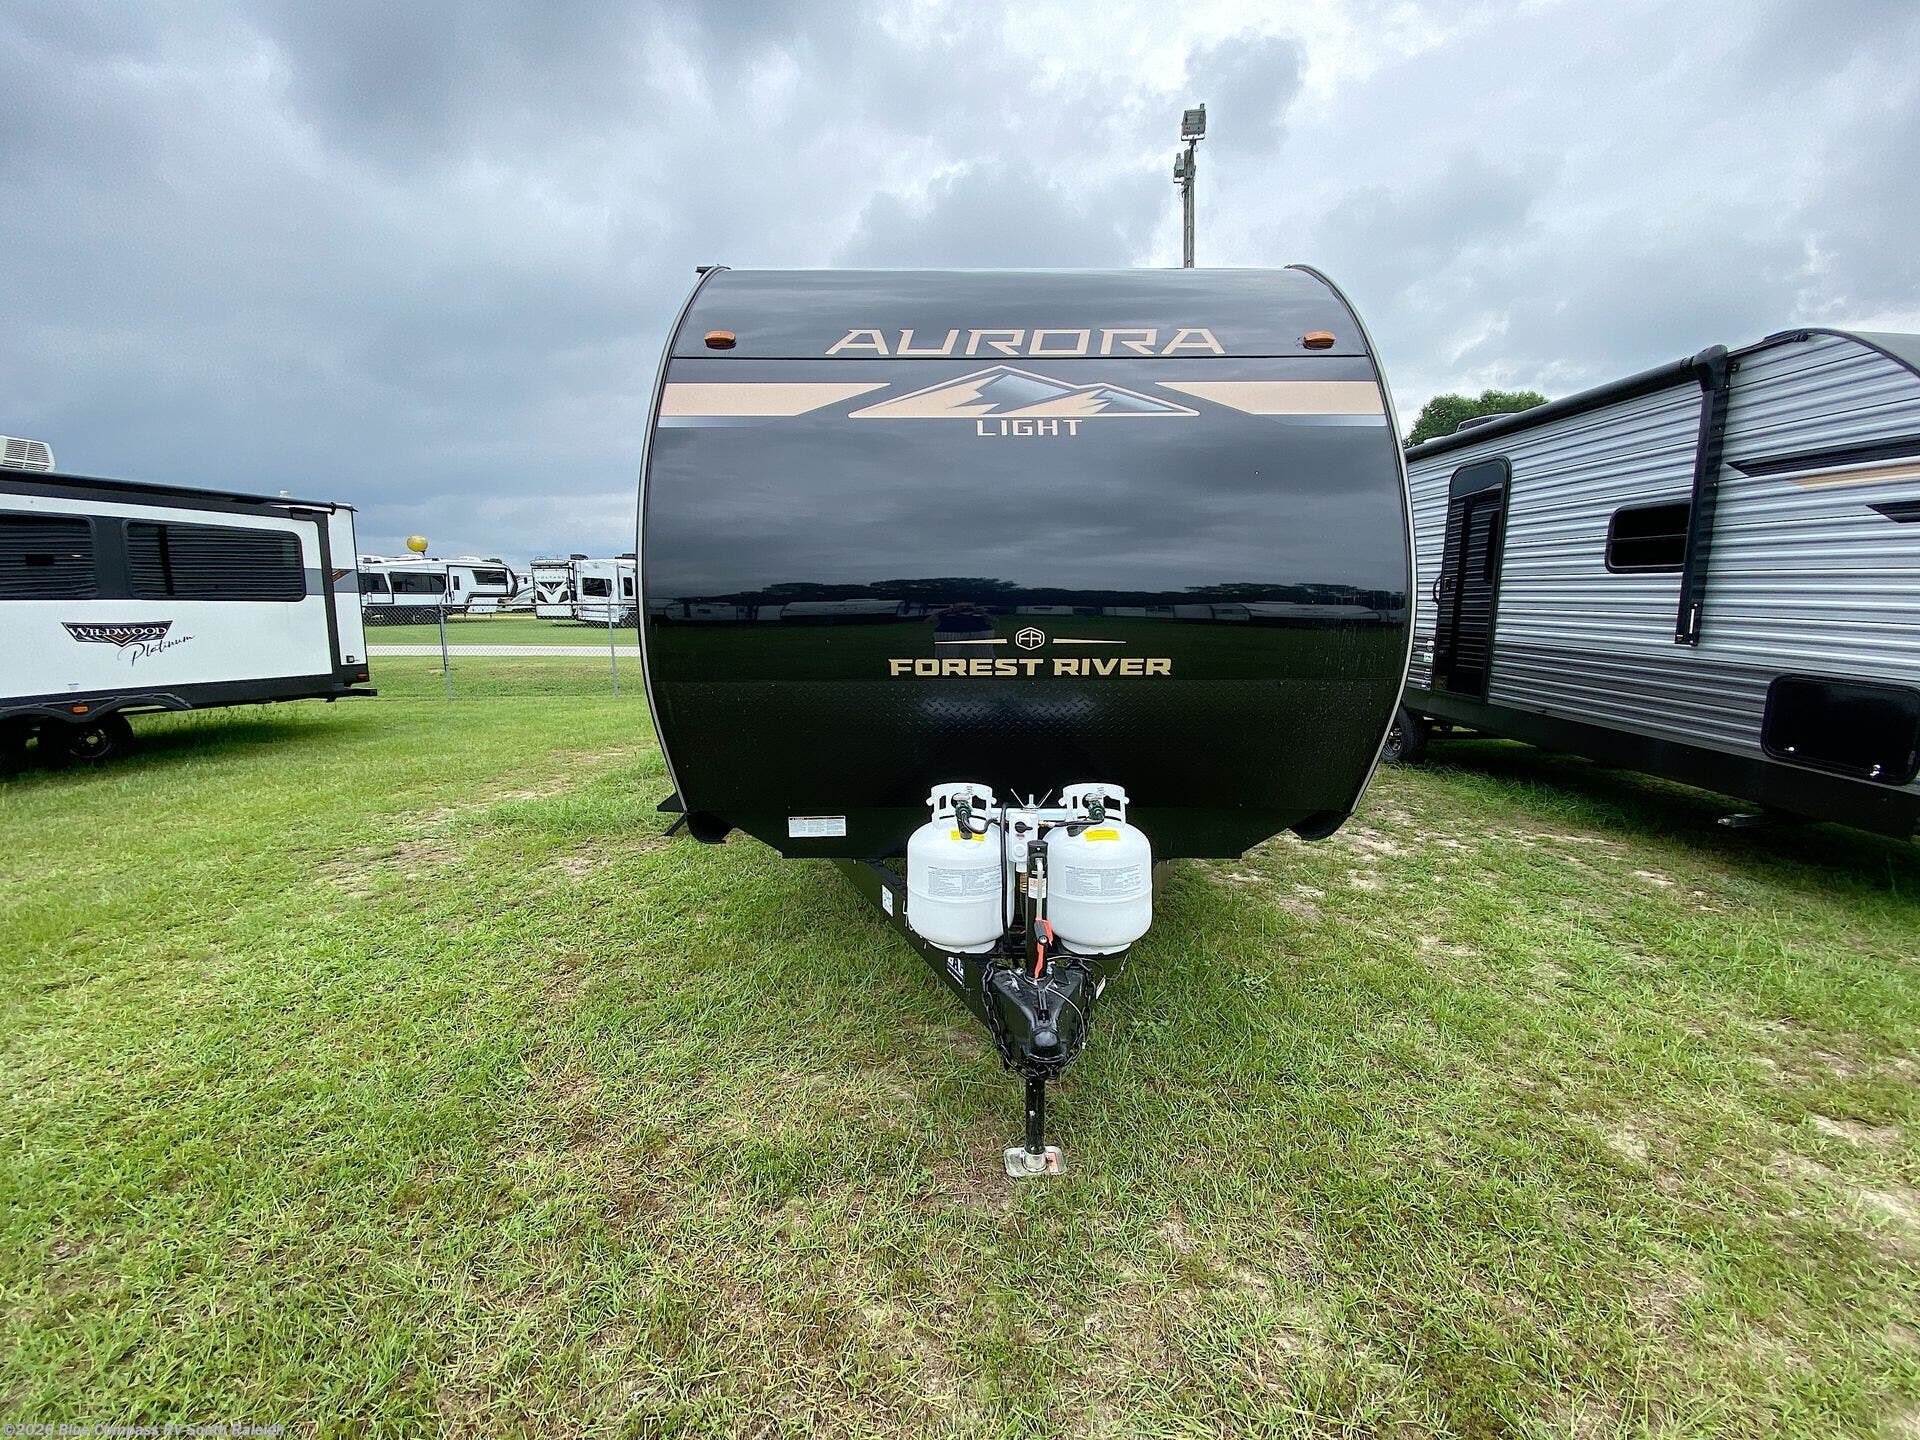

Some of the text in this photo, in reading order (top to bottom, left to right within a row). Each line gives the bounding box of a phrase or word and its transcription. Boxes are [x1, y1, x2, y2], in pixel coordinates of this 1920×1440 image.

[825, 328, 1227, 356] AURORA
[976, 419, 1083, 437] LIGHT
[68, 626, 168, 636] WILDWOOD
[116, 634, 195, 667] Platinum
[887, 657, 1173, 677] FOREST RIVER
